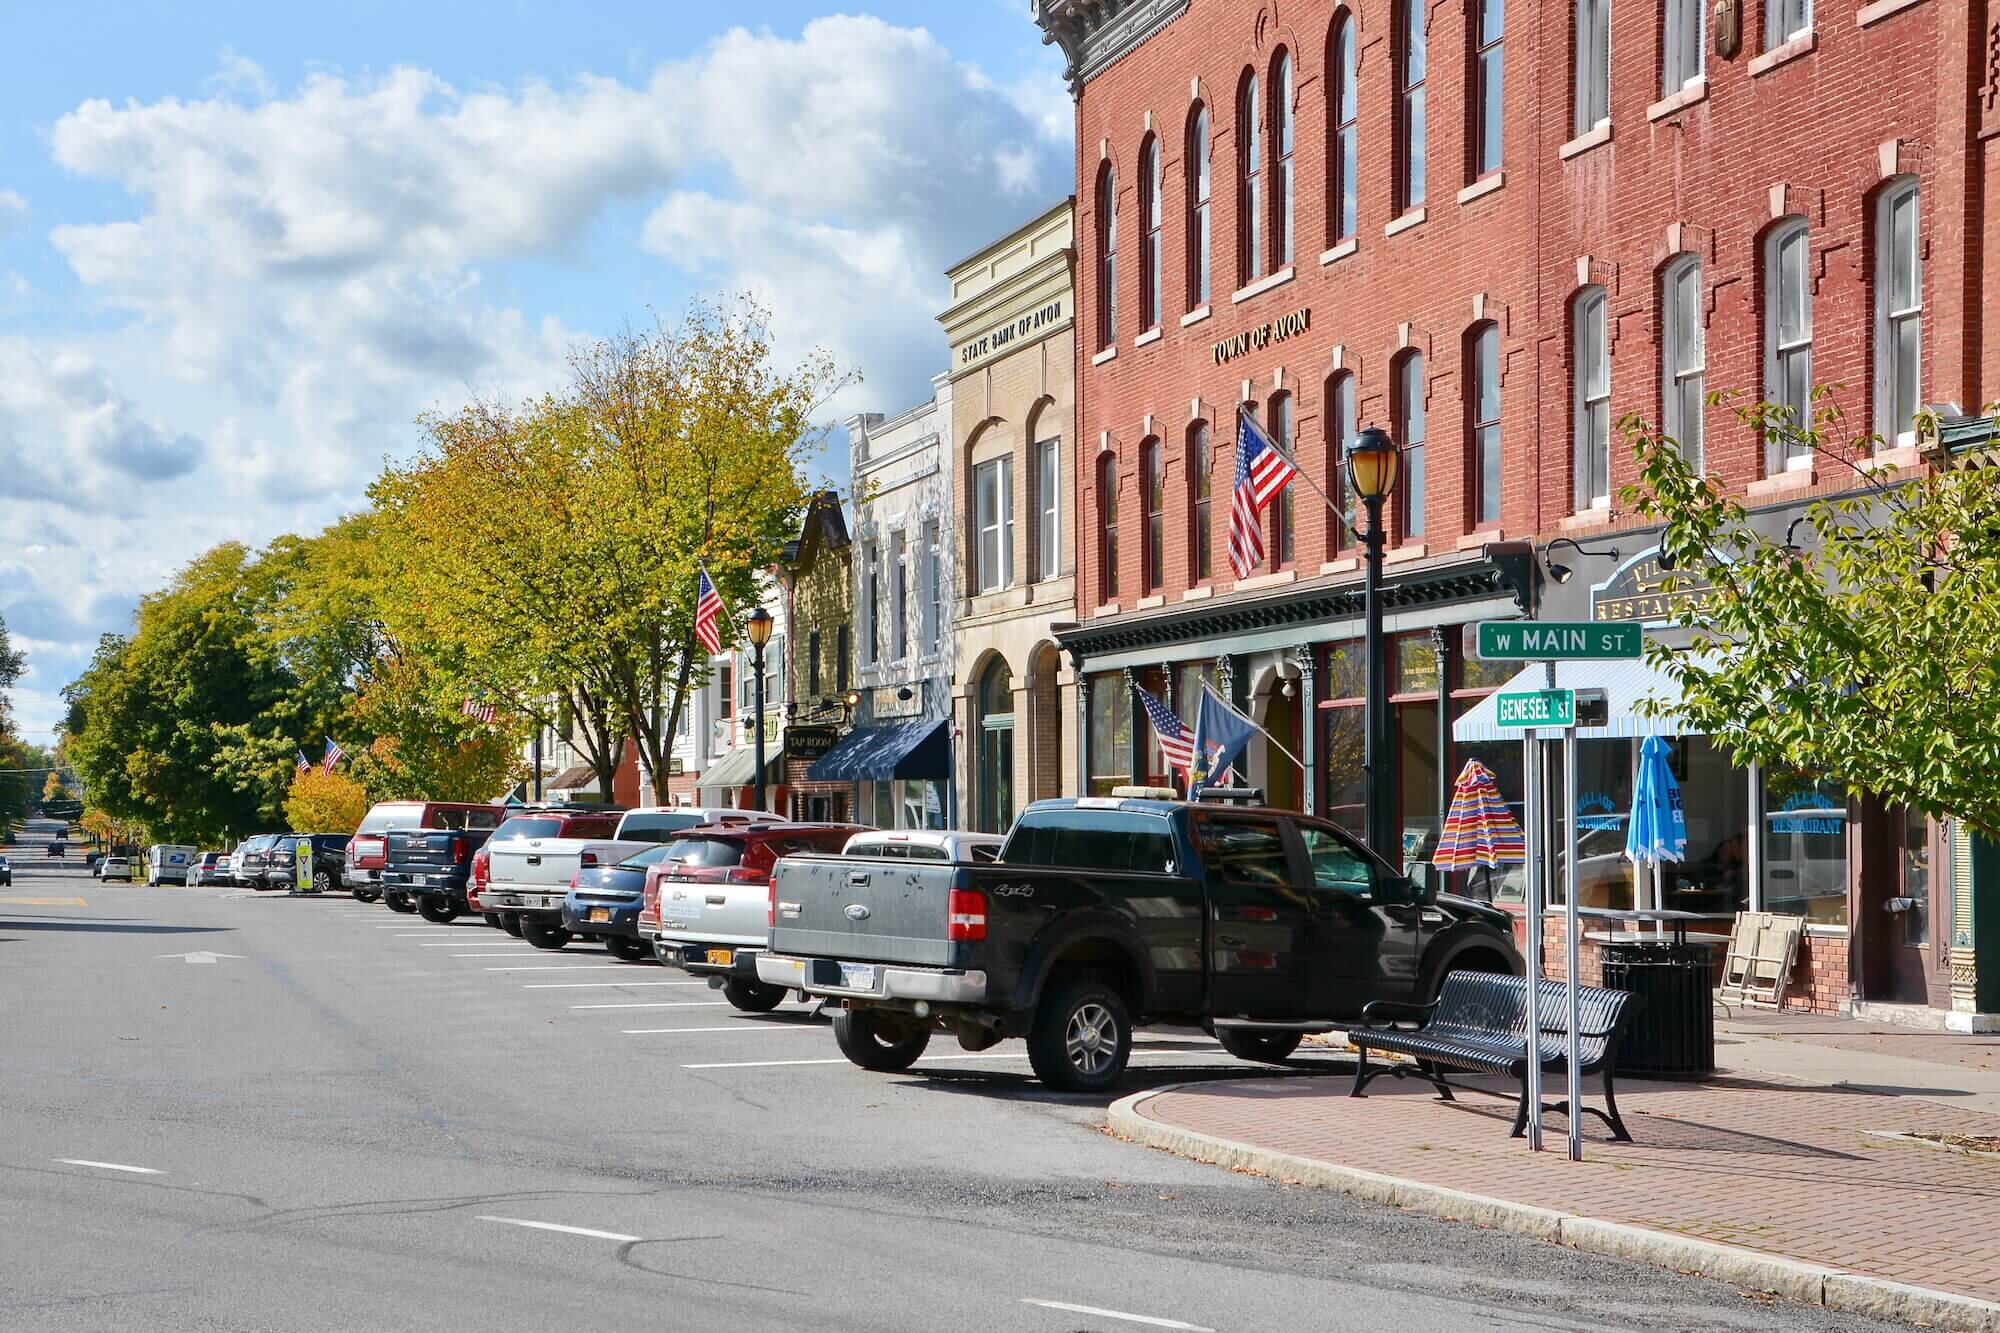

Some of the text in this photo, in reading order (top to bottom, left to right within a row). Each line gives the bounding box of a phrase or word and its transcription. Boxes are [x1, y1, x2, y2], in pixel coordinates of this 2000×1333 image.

[962, 301, 1061, 363] STATE BANK OF AVON
[1211, 308, 1308, 364] TOWN OF AVON
[1496, 629, 1625, 651] W MAIN ST
[1500, 695, 1570, 721] GENESEE ST
[790, 736, 832, 748] TAP ROOM
[1772, 817, 1841, 834] RESTAURANT
